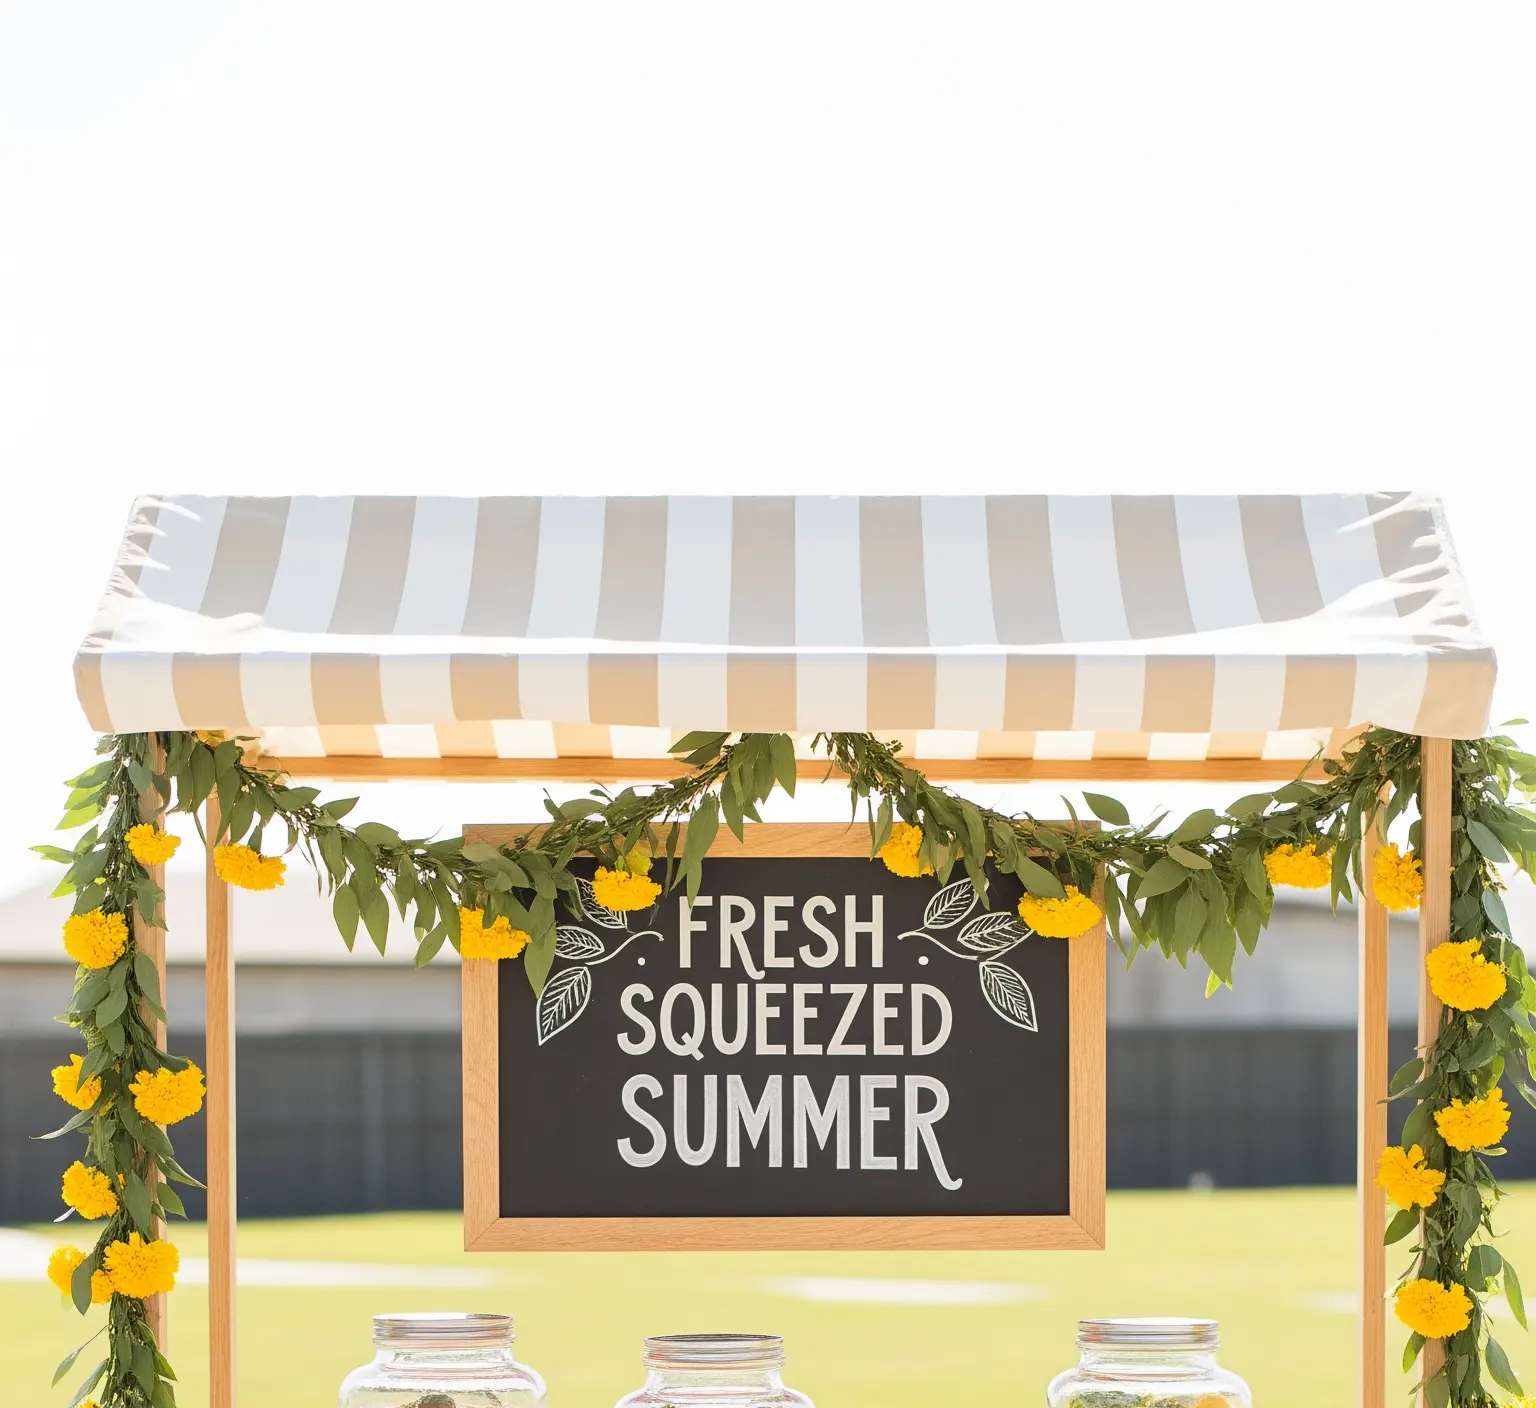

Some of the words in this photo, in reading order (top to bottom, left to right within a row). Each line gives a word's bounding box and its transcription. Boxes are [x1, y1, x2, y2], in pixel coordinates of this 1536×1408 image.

[679, 895, 883, 980] FRESH
[617, 983, 952, 1061] SQUEEZED
[617, 1074, 962, 1190] SUMMER
